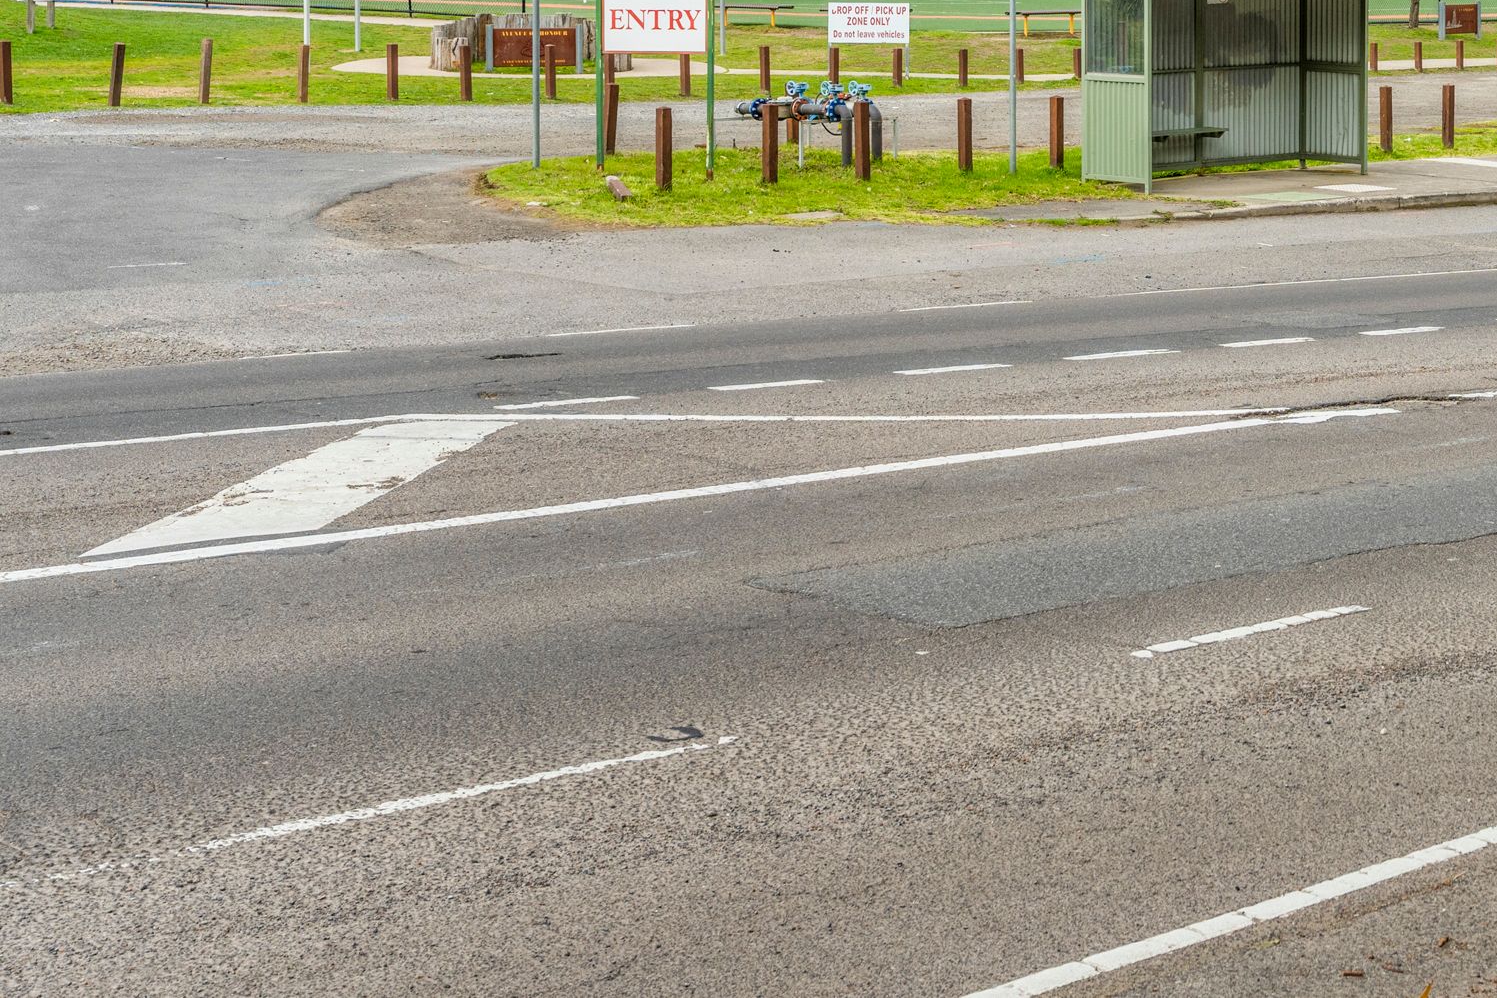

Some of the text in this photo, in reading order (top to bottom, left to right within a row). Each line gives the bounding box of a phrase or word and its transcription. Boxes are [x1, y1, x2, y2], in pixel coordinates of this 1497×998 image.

[855, 6, 869, 14] OFF
[876, 6, 894, 15] PICK
[896, 6, 907, 15] UP
[609, 9, 702, 30] ENTRY
[847, 17, 890, 25] ZONE ONLY
[833, 30, 905, 38] Do not leave vehicles
